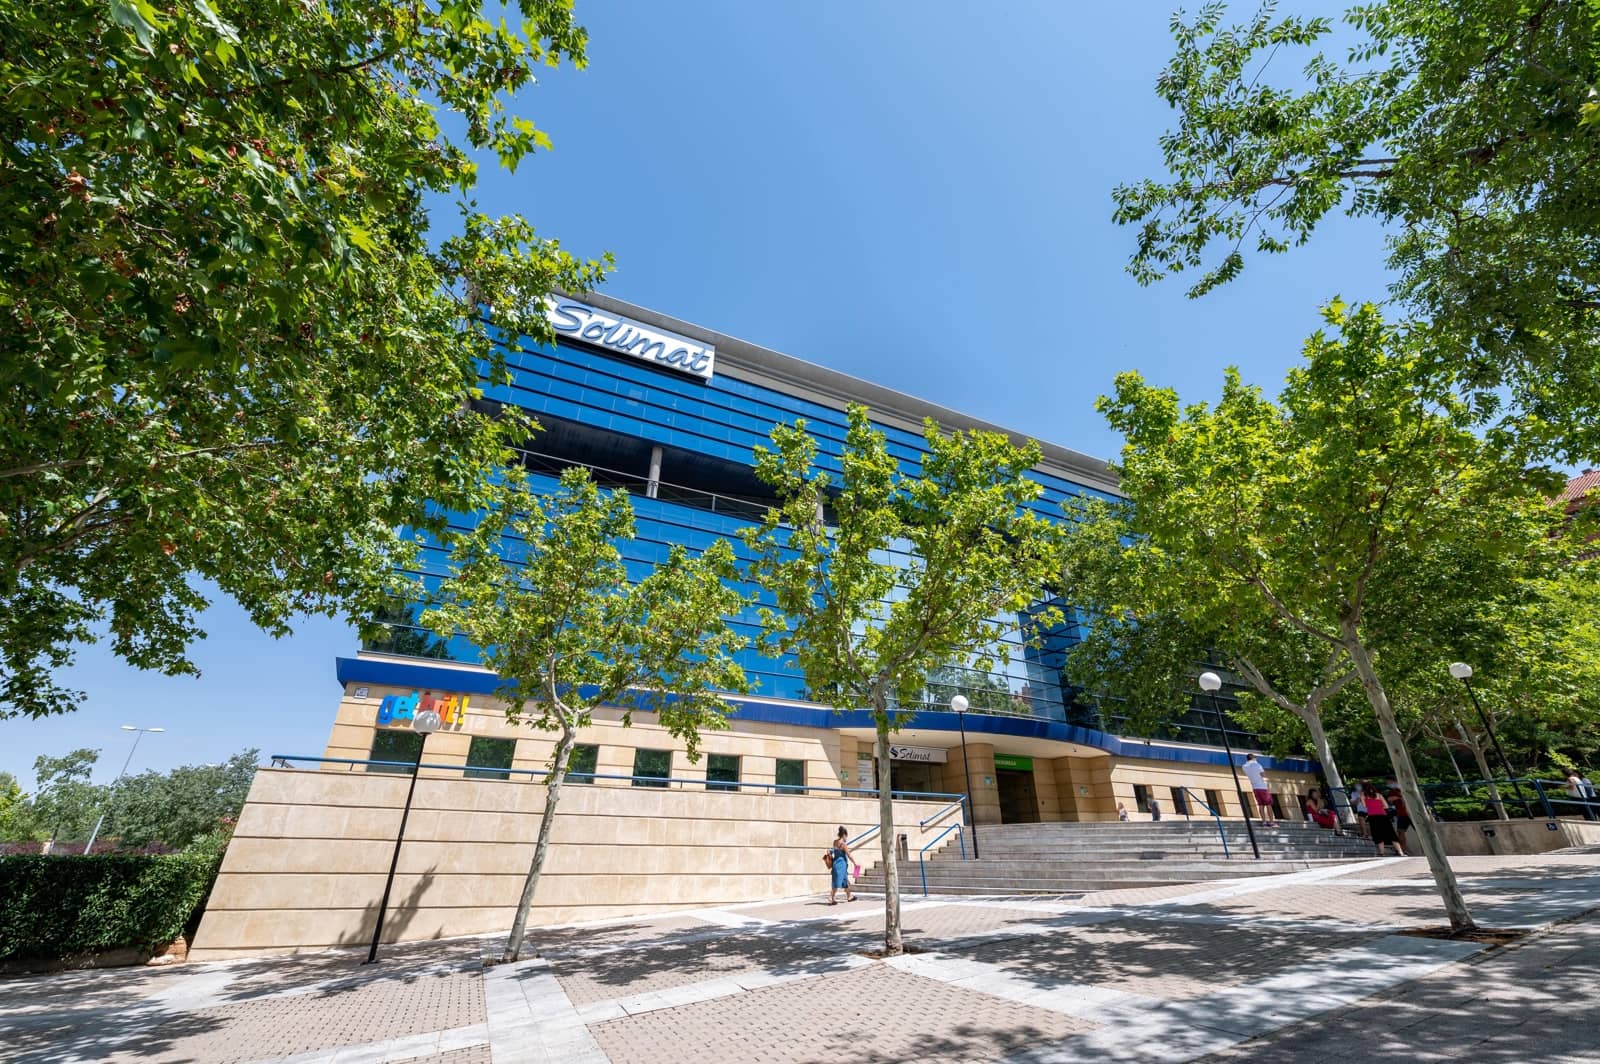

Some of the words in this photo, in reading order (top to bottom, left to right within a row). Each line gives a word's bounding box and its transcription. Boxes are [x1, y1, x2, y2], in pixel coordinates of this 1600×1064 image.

[552, 303, 711, 372] Solimat
[379, 690, 419, 724] get
[900, 748, 931, 762] Solimat
